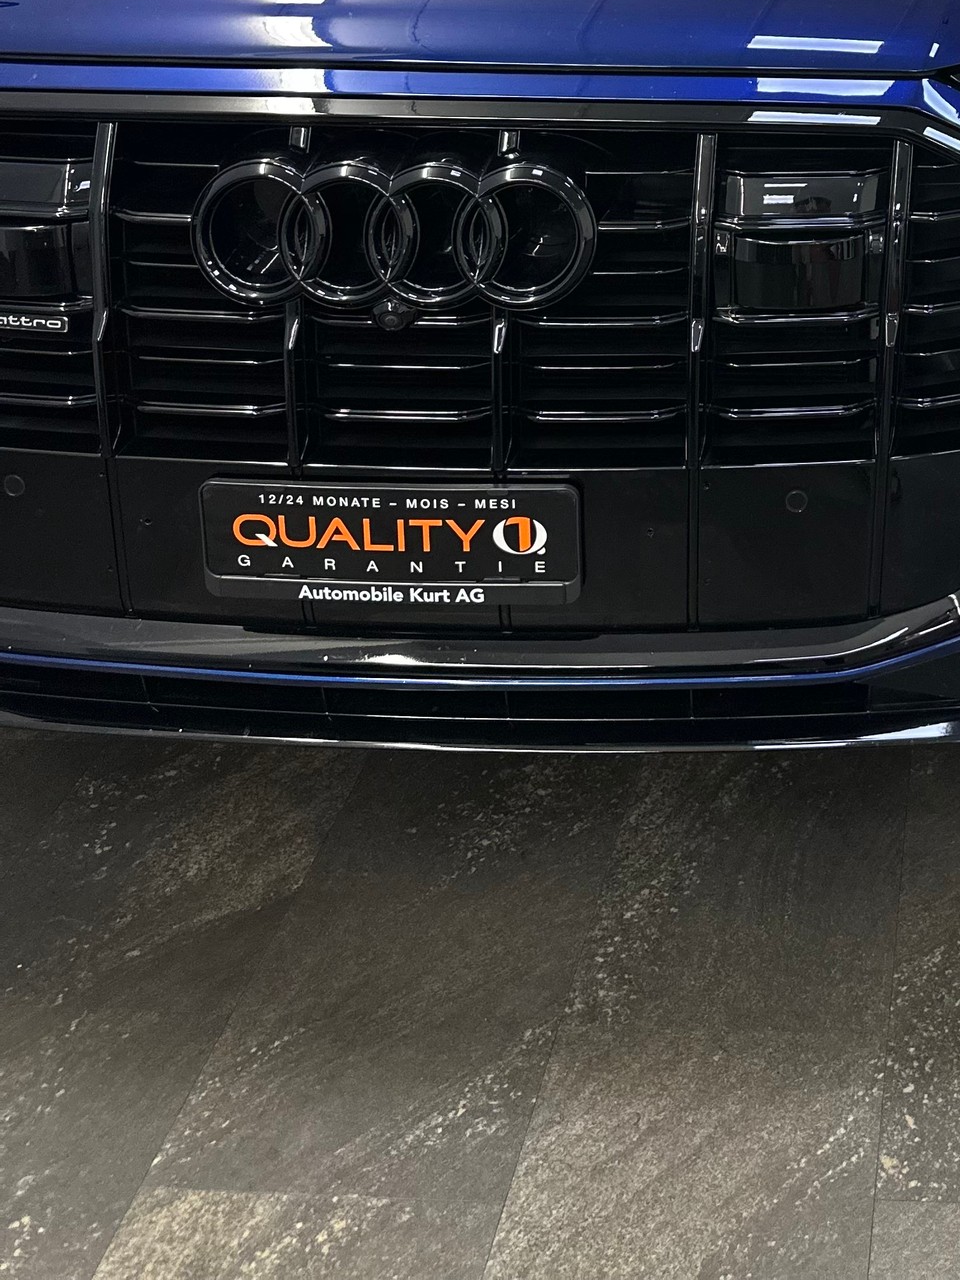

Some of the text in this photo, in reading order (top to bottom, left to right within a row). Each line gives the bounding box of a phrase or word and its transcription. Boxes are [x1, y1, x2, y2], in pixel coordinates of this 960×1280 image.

[258, 493, 305, 506] 12/24
[312, 496, 382, 509] MONATE
[406, 498, 450, 510] MOIS
[475, 498, 517, 510] MESI
[232, 513, 486, 552] QUALITY
[237, 554, 547, 573] GARANTIE
[299, 584, 486, 604] Automobile Kurt AG
